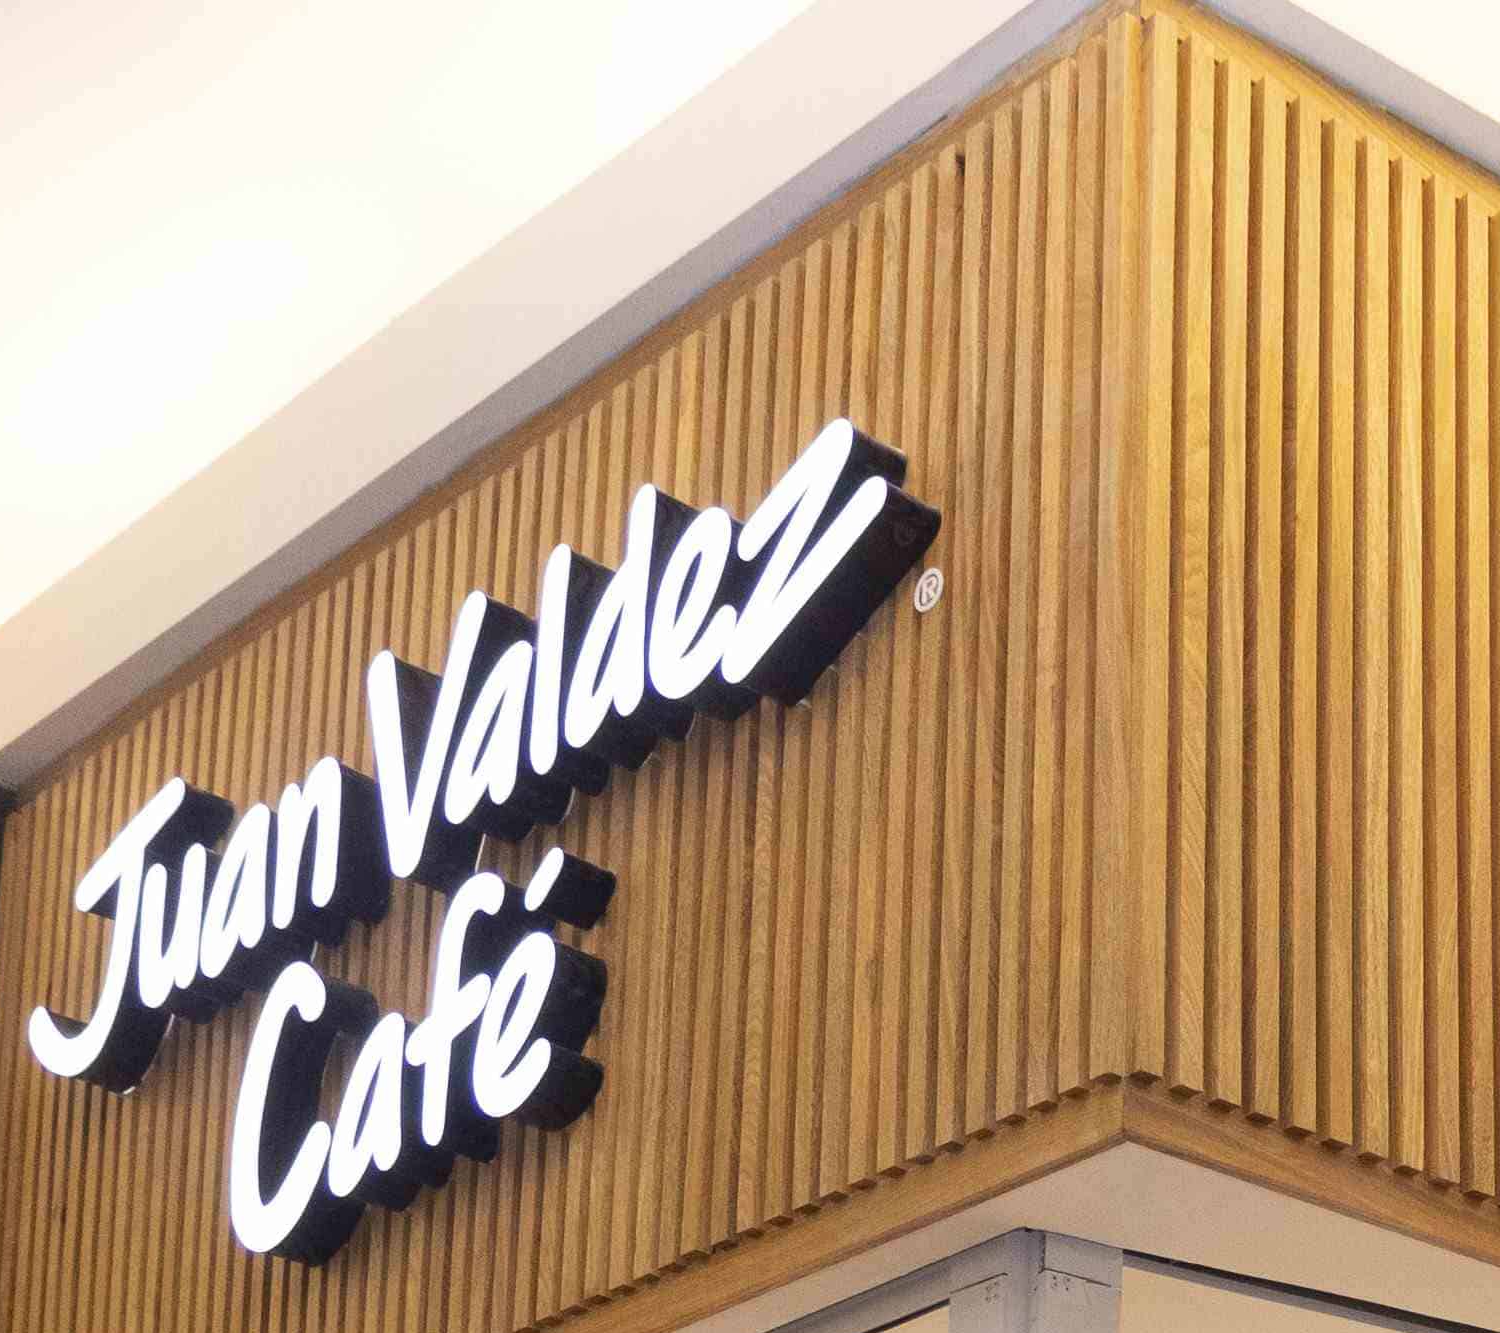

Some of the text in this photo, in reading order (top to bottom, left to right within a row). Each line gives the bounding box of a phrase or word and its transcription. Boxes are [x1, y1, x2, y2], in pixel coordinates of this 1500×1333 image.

[28, 417, 889, 1077] Juan Valdez
[229, 846, 565, 1253] Café
